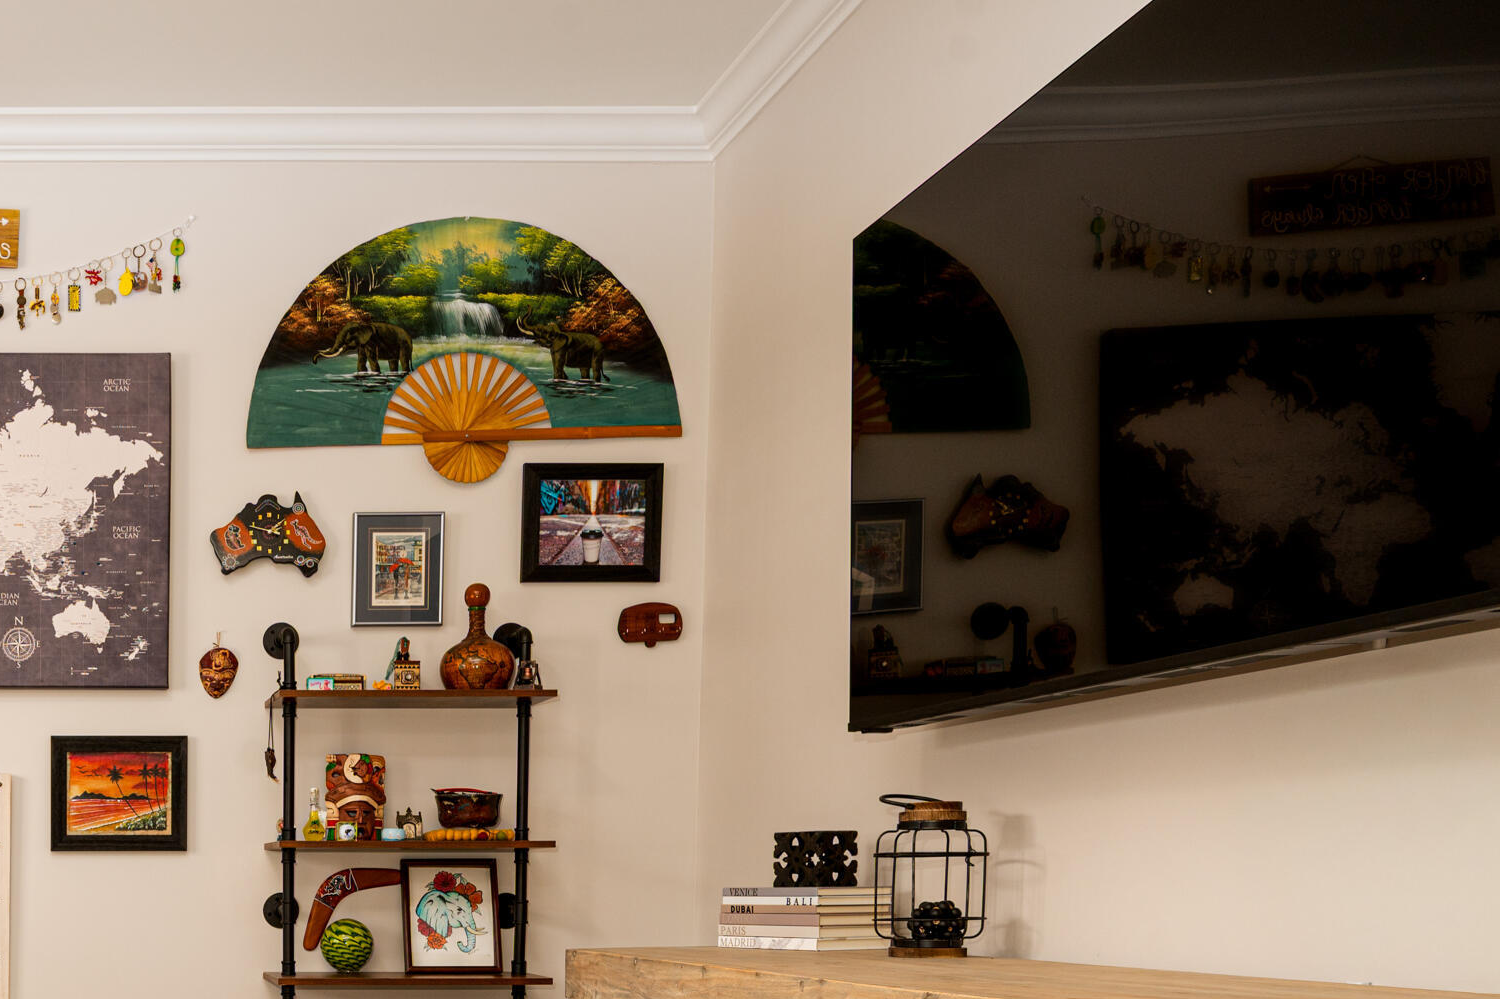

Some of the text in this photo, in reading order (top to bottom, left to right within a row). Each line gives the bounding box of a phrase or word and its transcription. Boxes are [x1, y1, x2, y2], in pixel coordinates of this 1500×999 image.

[14, 616, 24, 626] N
[16, 661, 22, 669] S
[729, 887, 758, 897] VENICE
[786, 897, 813, 906] BALI
[730, 905, 754, 914] DUBAI
[720, 926, 747, 936] PARIS
[719, 937, 757, 948] MADRID
